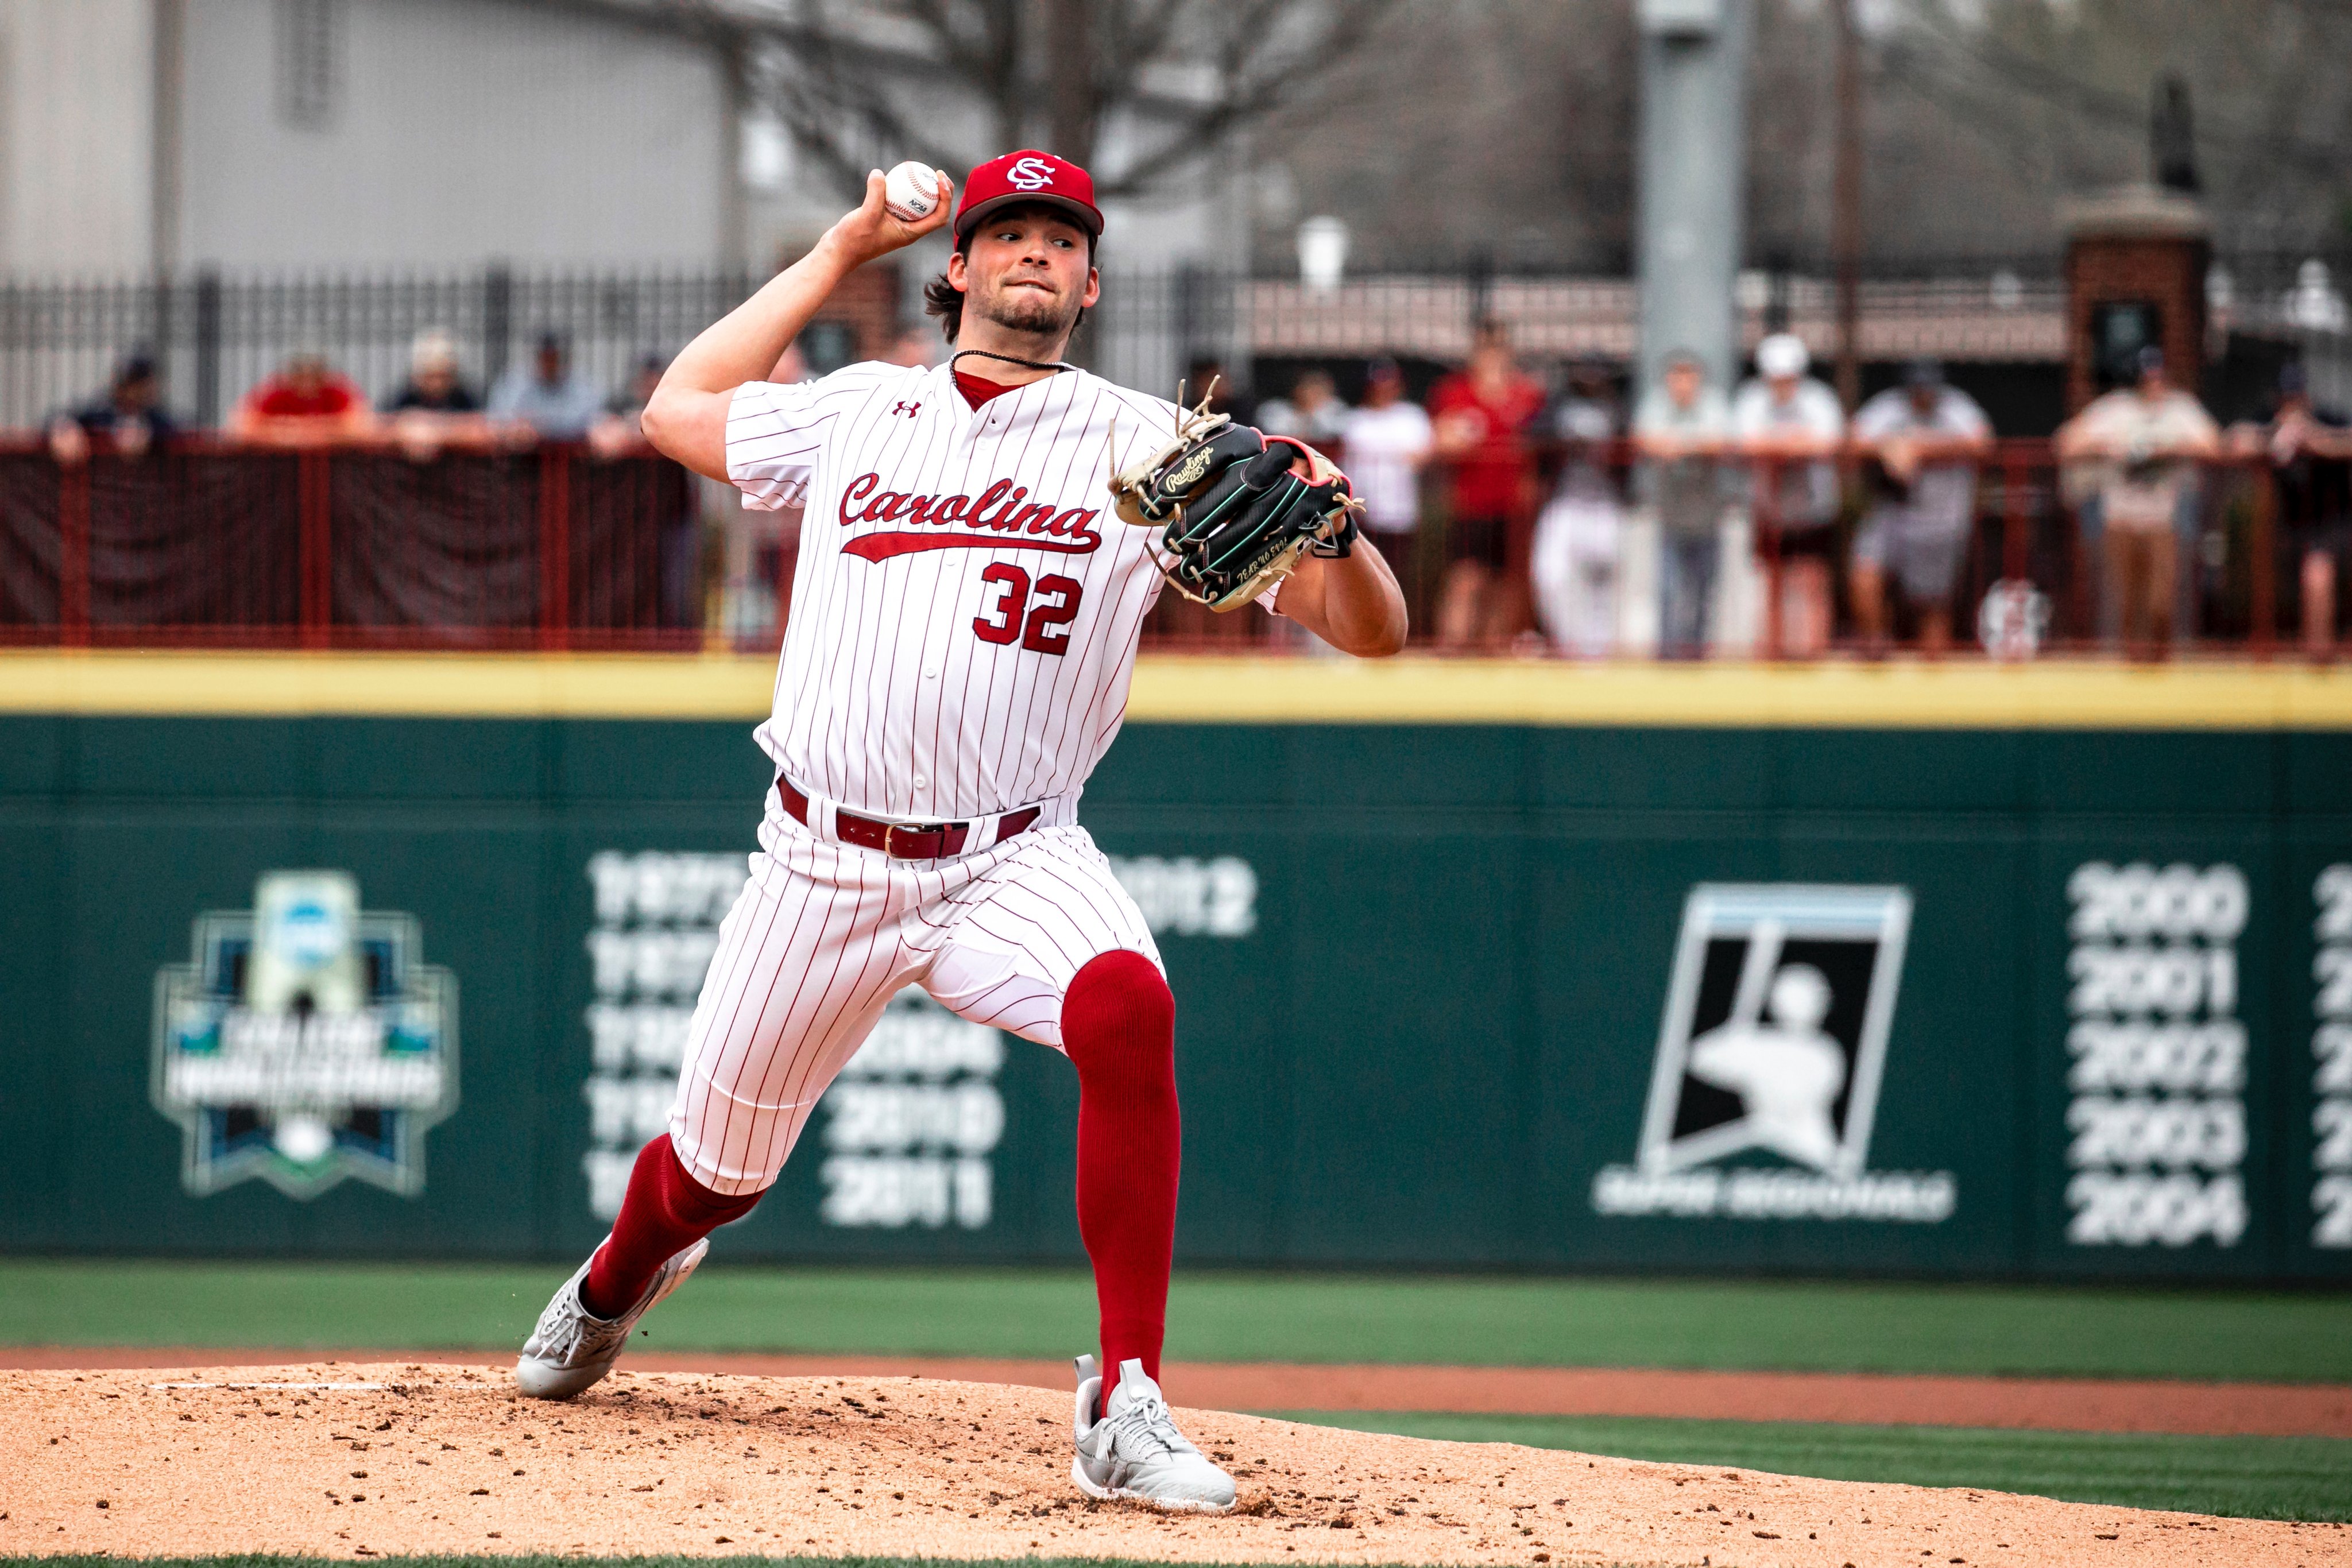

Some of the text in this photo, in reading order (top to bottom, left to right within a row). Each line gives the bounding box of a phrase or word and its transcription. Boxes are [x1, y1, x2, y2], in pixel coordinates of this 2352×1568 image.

[909, 199, 927, 213] NCAA
[1165, 446, 1214, 492] Rawlings
[839, 472, 1101, 545] Carolina
[1236, 536, 1289, 584] FEAR NO EVIL
[972, 561, 1084, 657] 32
[2067, 864, 2250, 937] 2000
[2067, 944, 2238, 1013] 2001
[2066, 1022, 2249, 1090] 2002
[2066, 1097, 2249, 1167] 2003
[819, 1154, 993, 1229] 2011
[2066, 1171, 2249, 1246] 2004
